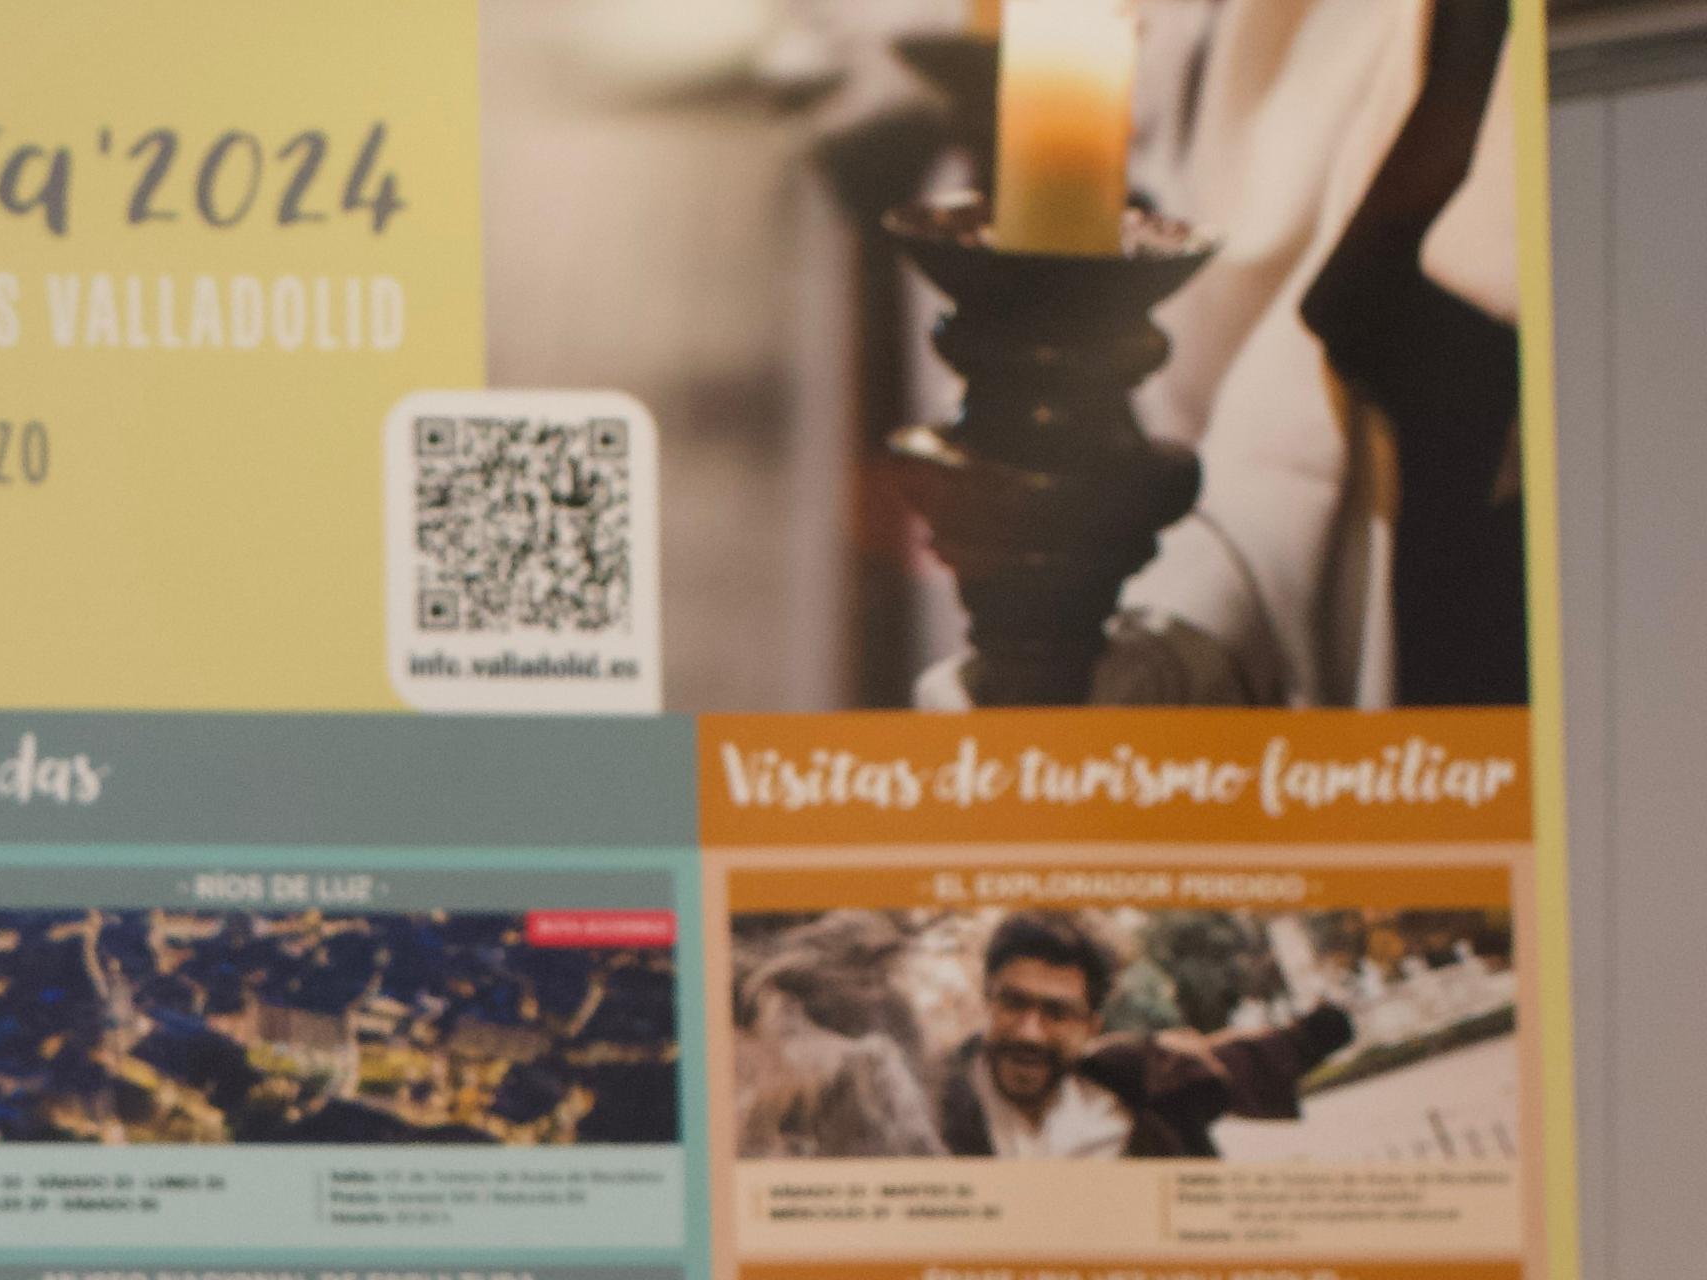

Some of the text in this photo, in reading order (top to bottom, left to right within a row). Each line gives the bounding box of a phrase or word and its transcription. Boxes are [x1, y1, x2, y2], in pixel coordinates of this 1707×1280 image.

[45, 275, 407, 352] VALLADOLID
[722, 739, 1516, 816] Visitas de turismo familiar
[271, 875, 309, 902] DE
[317, 875, 373, 902] LUZ
[934, 875, 968, 901] EL
[975, 873, 1173, 901] EXPLORADOR
